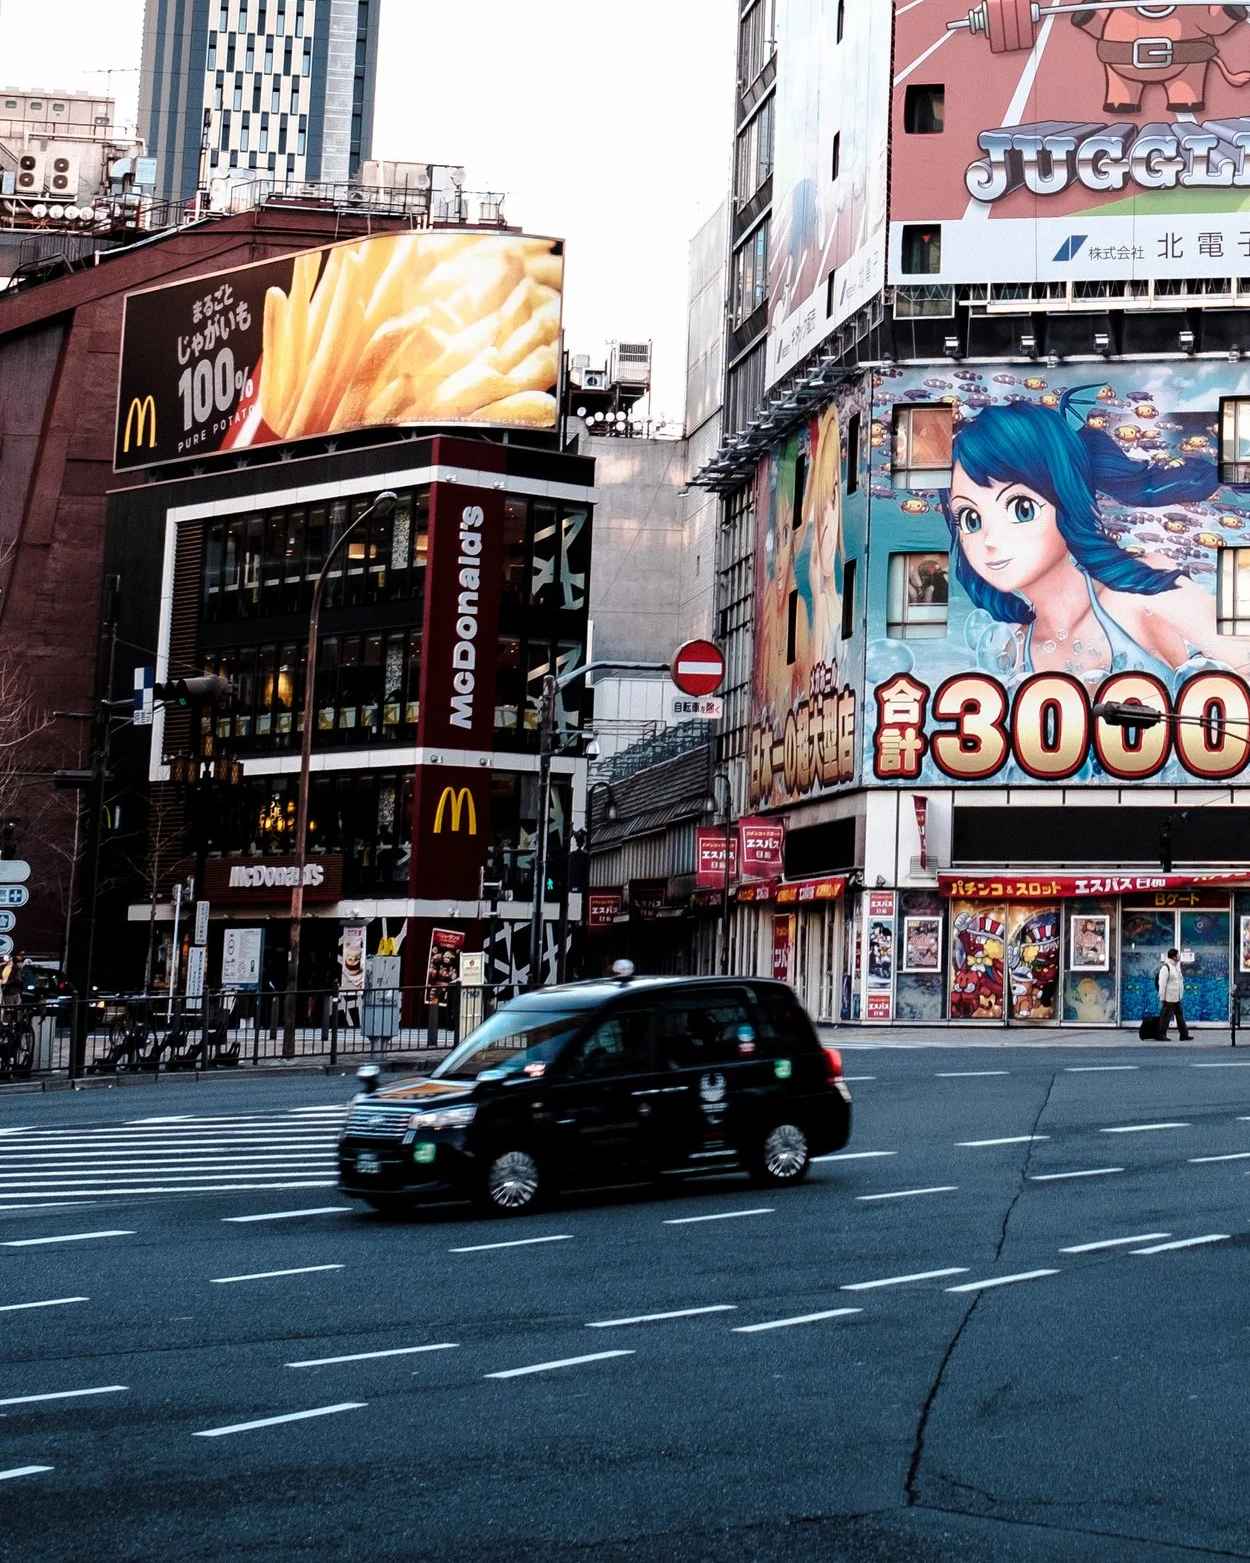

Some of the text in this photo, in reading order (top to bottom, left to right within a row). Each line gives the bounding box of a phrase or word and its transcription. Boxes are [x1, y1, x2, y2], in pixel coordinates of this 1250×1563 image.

[1088, 244, 1145, 261] 株式会社
[192, 284, 234, 324] まるごと
[177, 300, 252, 366] じゃがいも
[178, 346, 254, 431] 100%
[178, 404, 254, 453] PURE POTATO
[450, 505, 485, 730] McDonald's
[878, 673, 930, 778] 合計
[746, 838, 780, 850] エスパス
[229, 863, 324, 888] McDonad's
[1154, 893, 1200, 907] Bゲート
